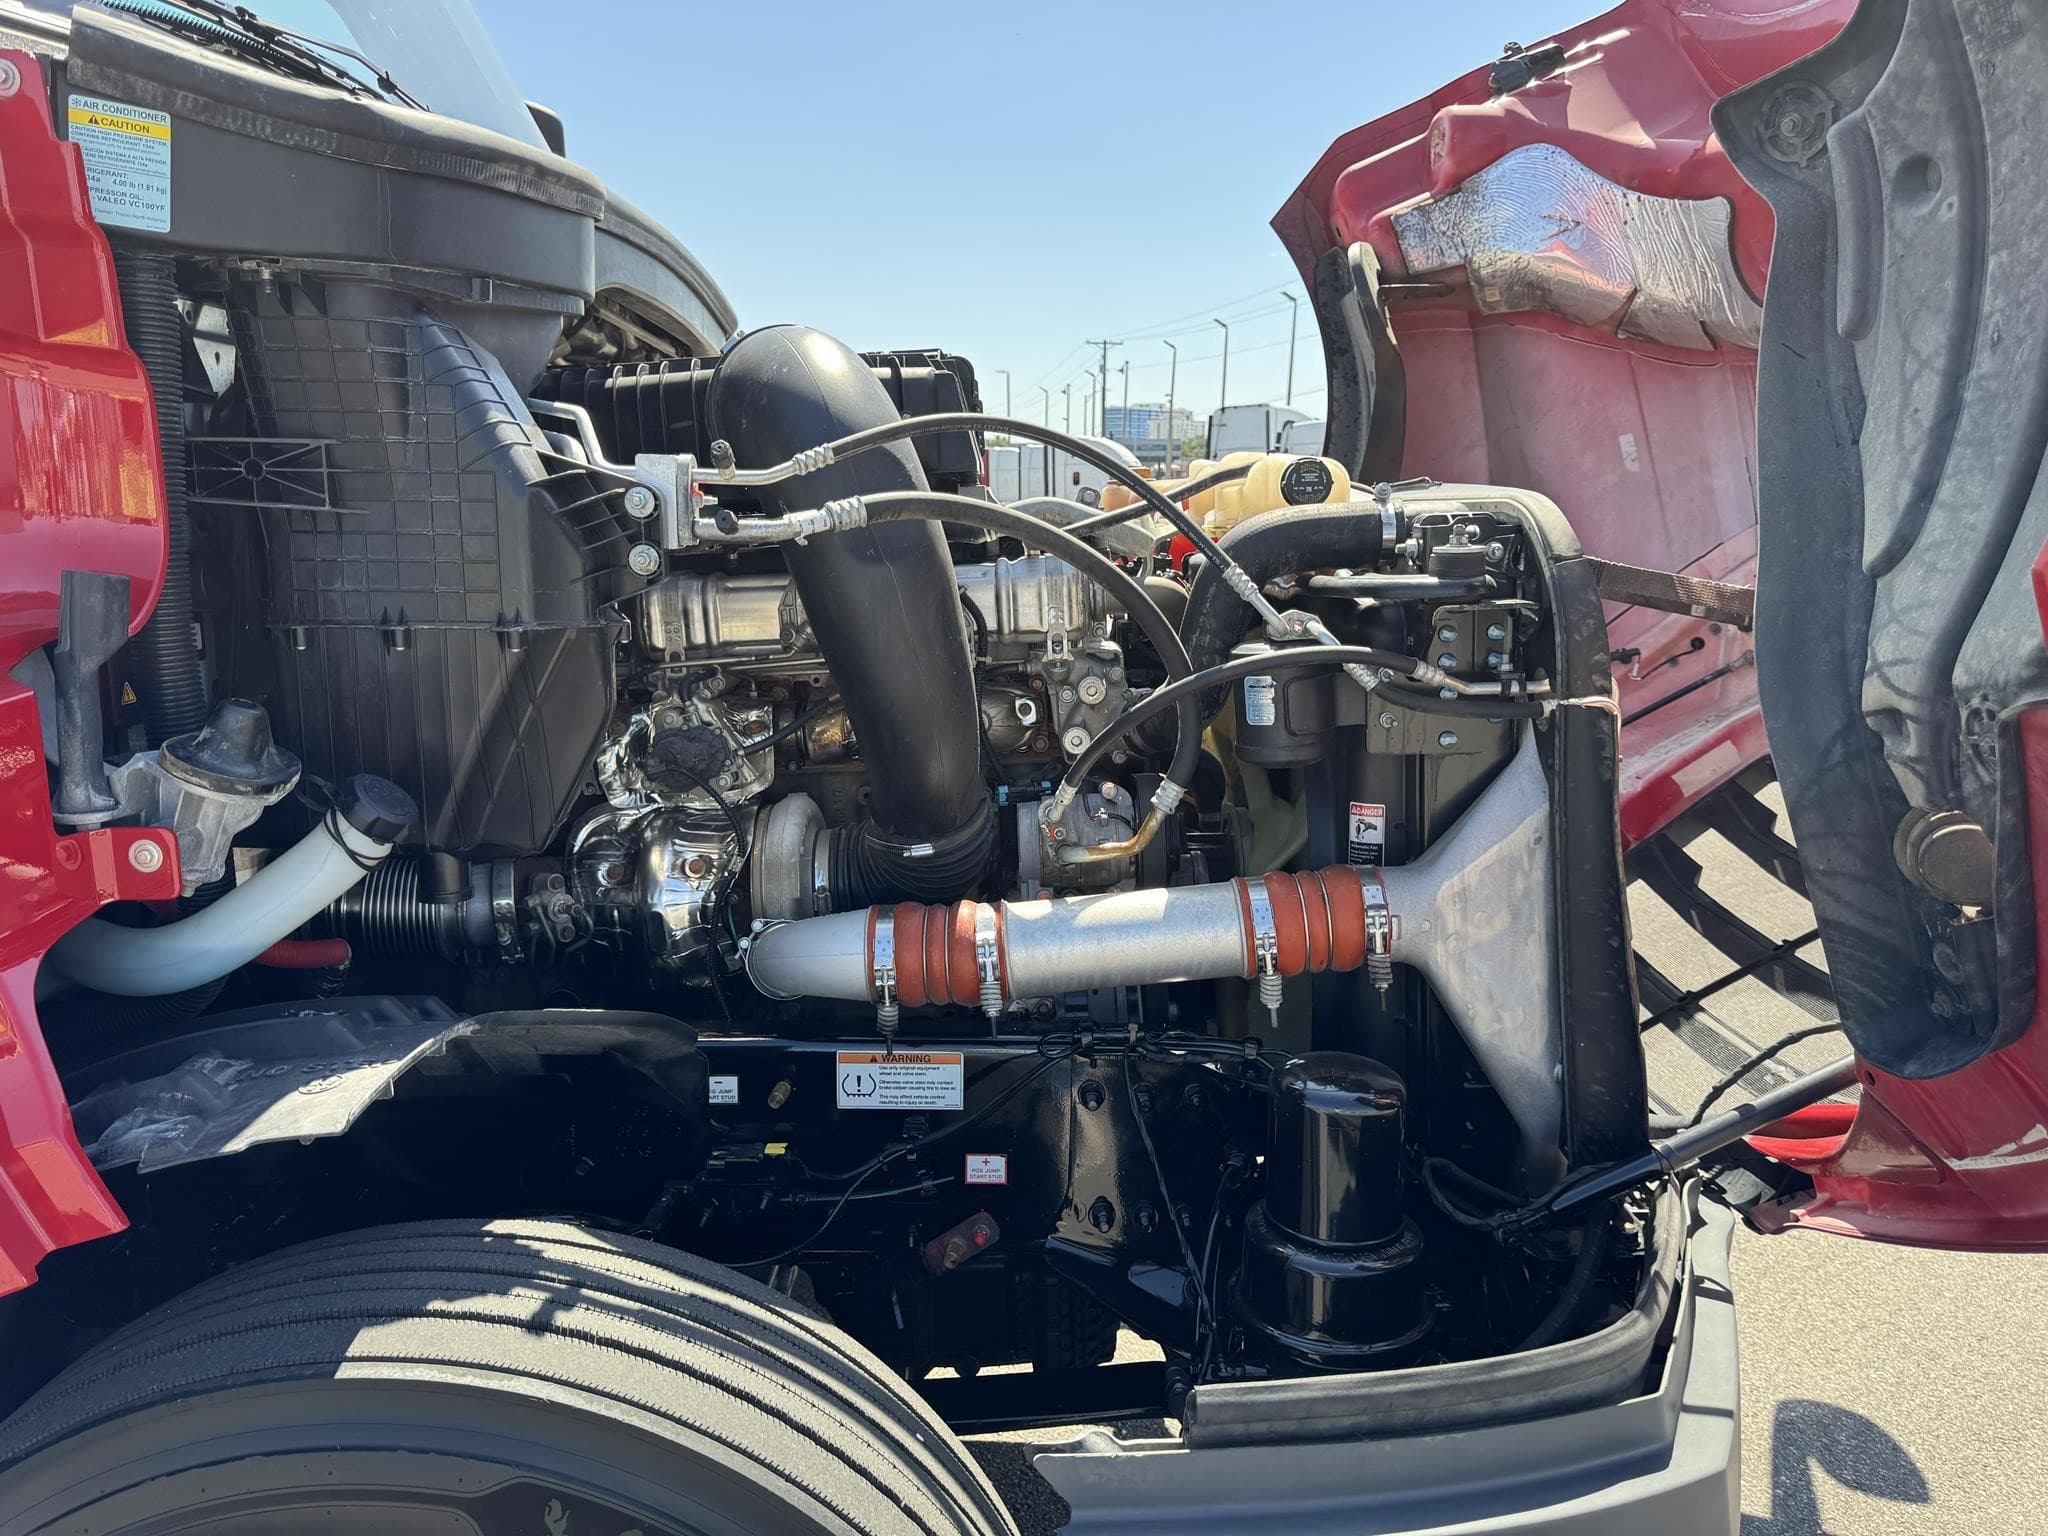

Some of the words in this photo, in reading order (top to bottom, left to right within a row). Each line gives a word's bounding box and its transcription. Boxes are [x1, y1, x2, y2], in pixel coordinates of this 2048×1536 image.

[83, 100, 99, 111] AIR
[102, 104, 167, 123] CONDITIONER
[70, 125, 96, 133] CAUTION
[113, 131, 143, 142] PRESSURE
[101, 118, 150, 134] CAUTION
[71, 131, 100, 140] CONTAINS
[101, 136, 141, 148] REFRIGERANT
[87, 167, 129, 180] RIGERANT:
[88, 186, 127, 198] PRESSOR
[112, 178, 128, 187] 4.00
[129, 180, 136, 189] lb
[138, 183, 154, 192] (1.81
[156, 186, 168, 195] kg)
[96, 194, 126, 205] VALEO
[129, 200, 166, 212] VC100YF
[1356, 807, 1382, 816] DANGER
[881, 1054, 931, 1063] WARNING
